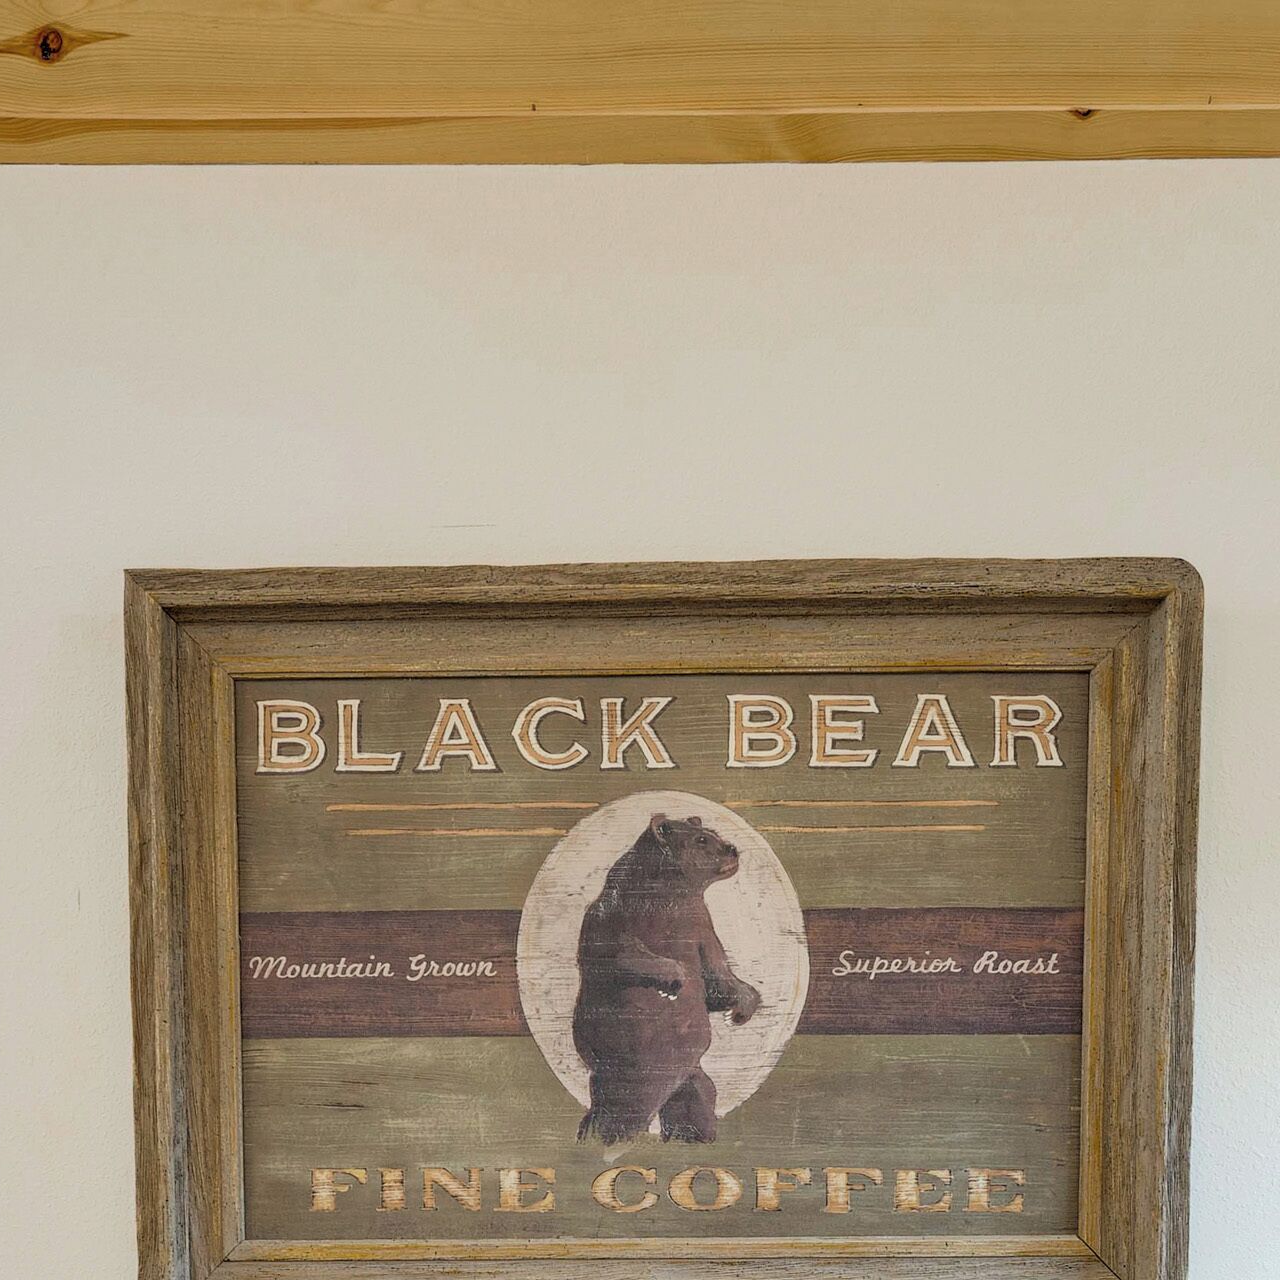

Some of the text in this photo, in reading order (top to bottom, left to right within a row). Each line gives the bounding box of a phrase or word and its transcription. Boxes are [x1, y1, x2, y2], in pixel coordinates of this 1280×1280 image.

[254, 692, 1065, 774] BLACK BEAR
[249, 953, 497, 983] Mountain Grown
[831, 949, 1062, 978] Superior Roast
[310, 1165, 1026, 1213] FINE COFFEE
